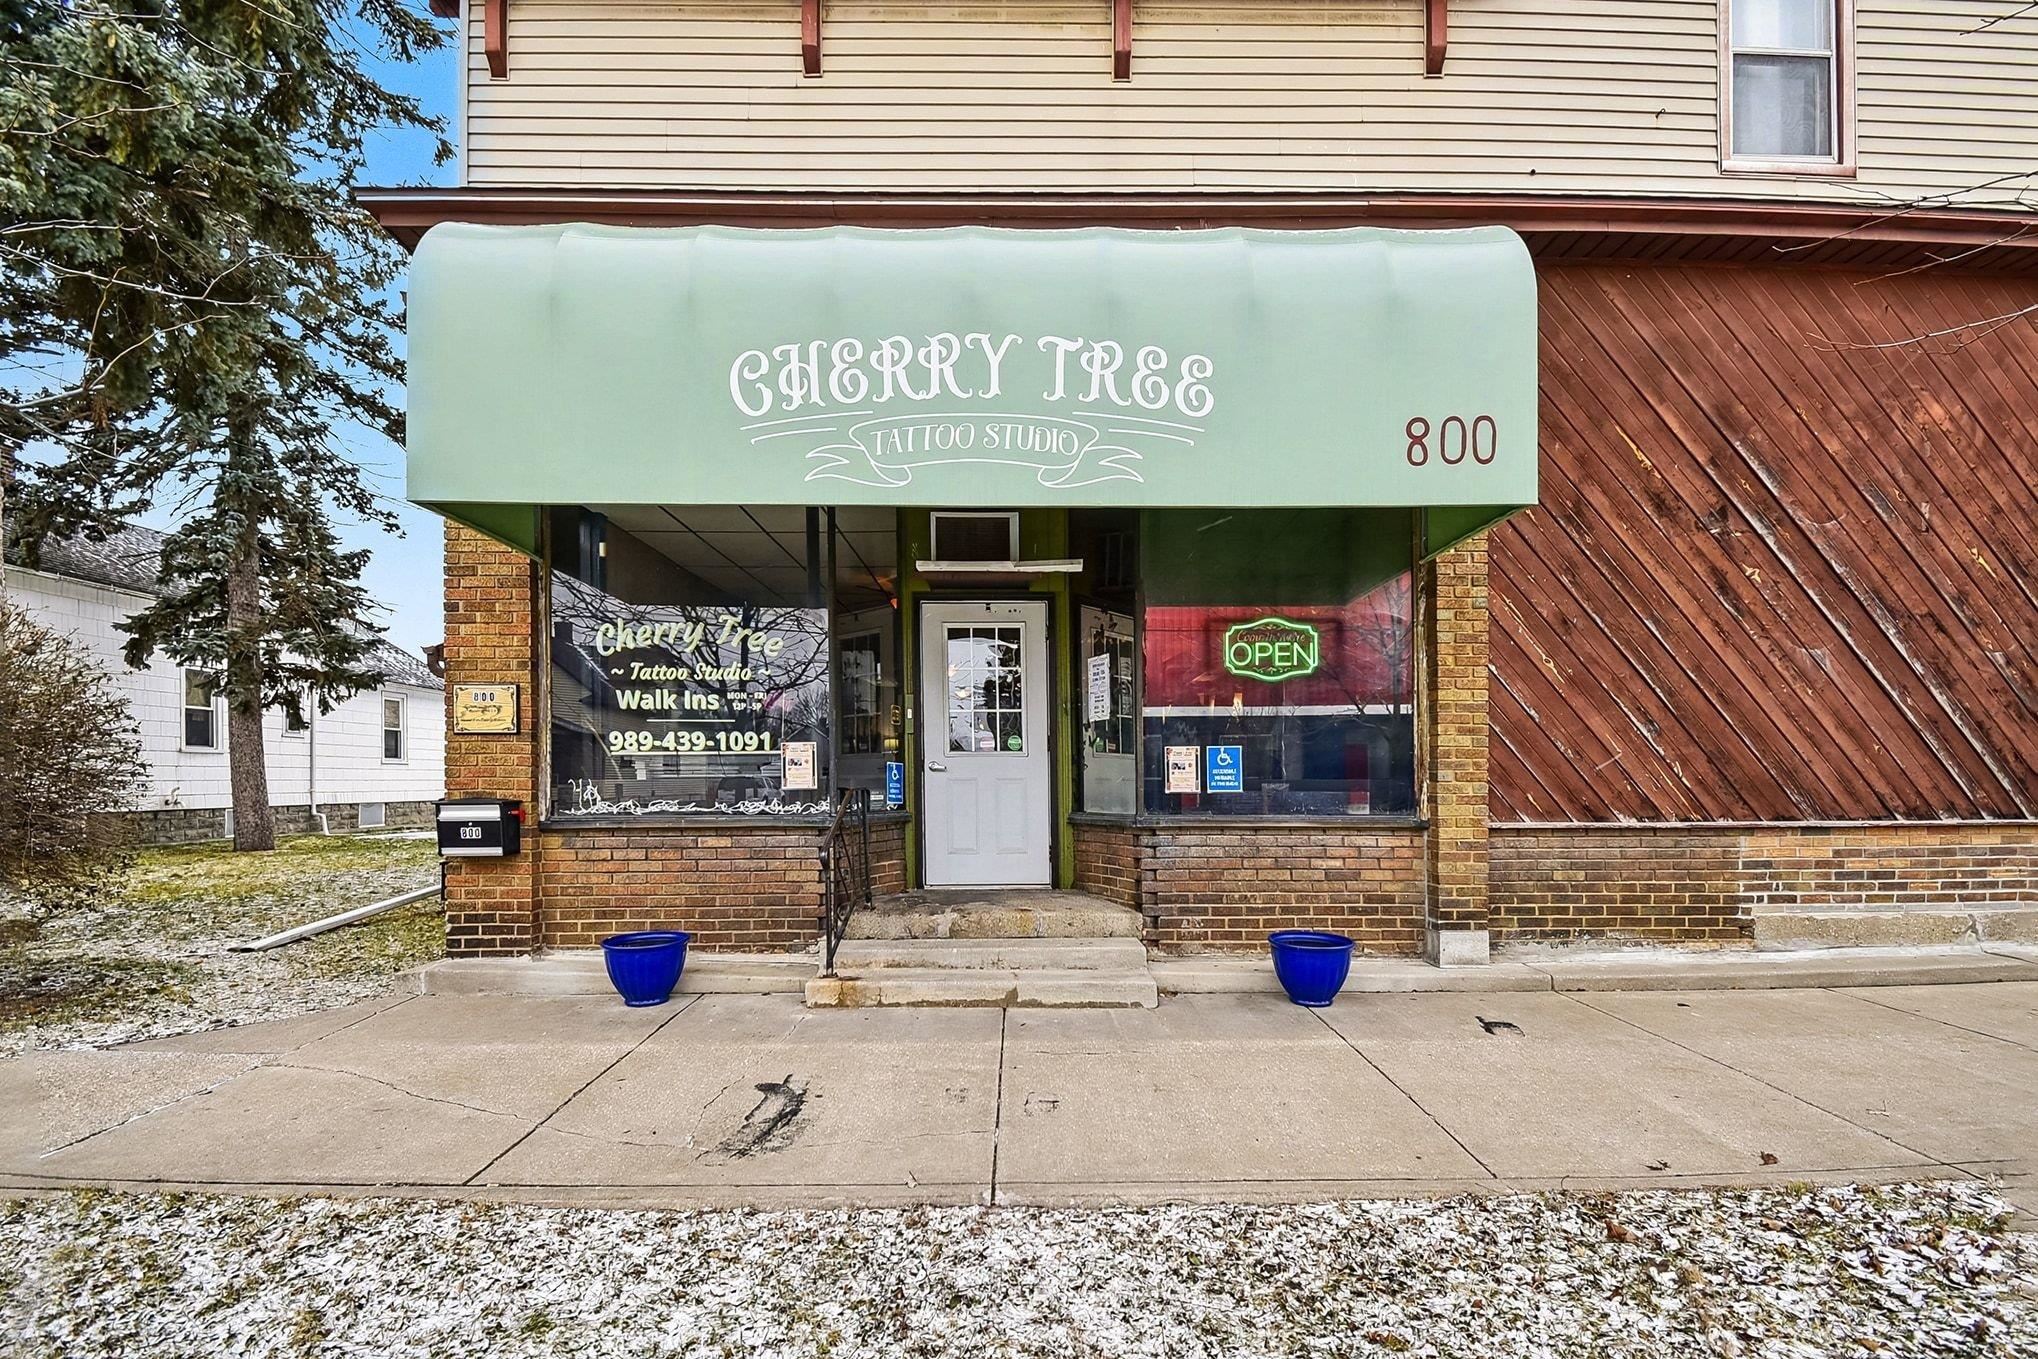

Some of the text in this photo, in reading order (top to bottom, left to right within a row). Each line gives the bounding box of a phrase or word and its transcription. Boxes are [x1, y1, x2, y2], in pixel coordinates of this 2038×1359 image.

[729, 332, 1215, 418] CHERRY TREE
[869, 422, 1081, 457] TATTOO STUDIO
[1405, 414, 1497, 467] 800
[596, 614, 784, 657] Cherry Tree
[1230, 642, 1314, 666] OPEN
[630, 662, 752, 681] Tattoo Studio
[474, 692, 495, 701] 800
[615, 689, 720, 710] Walk Ins
[609, 730, 772, 752] 989-439-1091
[462, 828, 480, 838] 800
